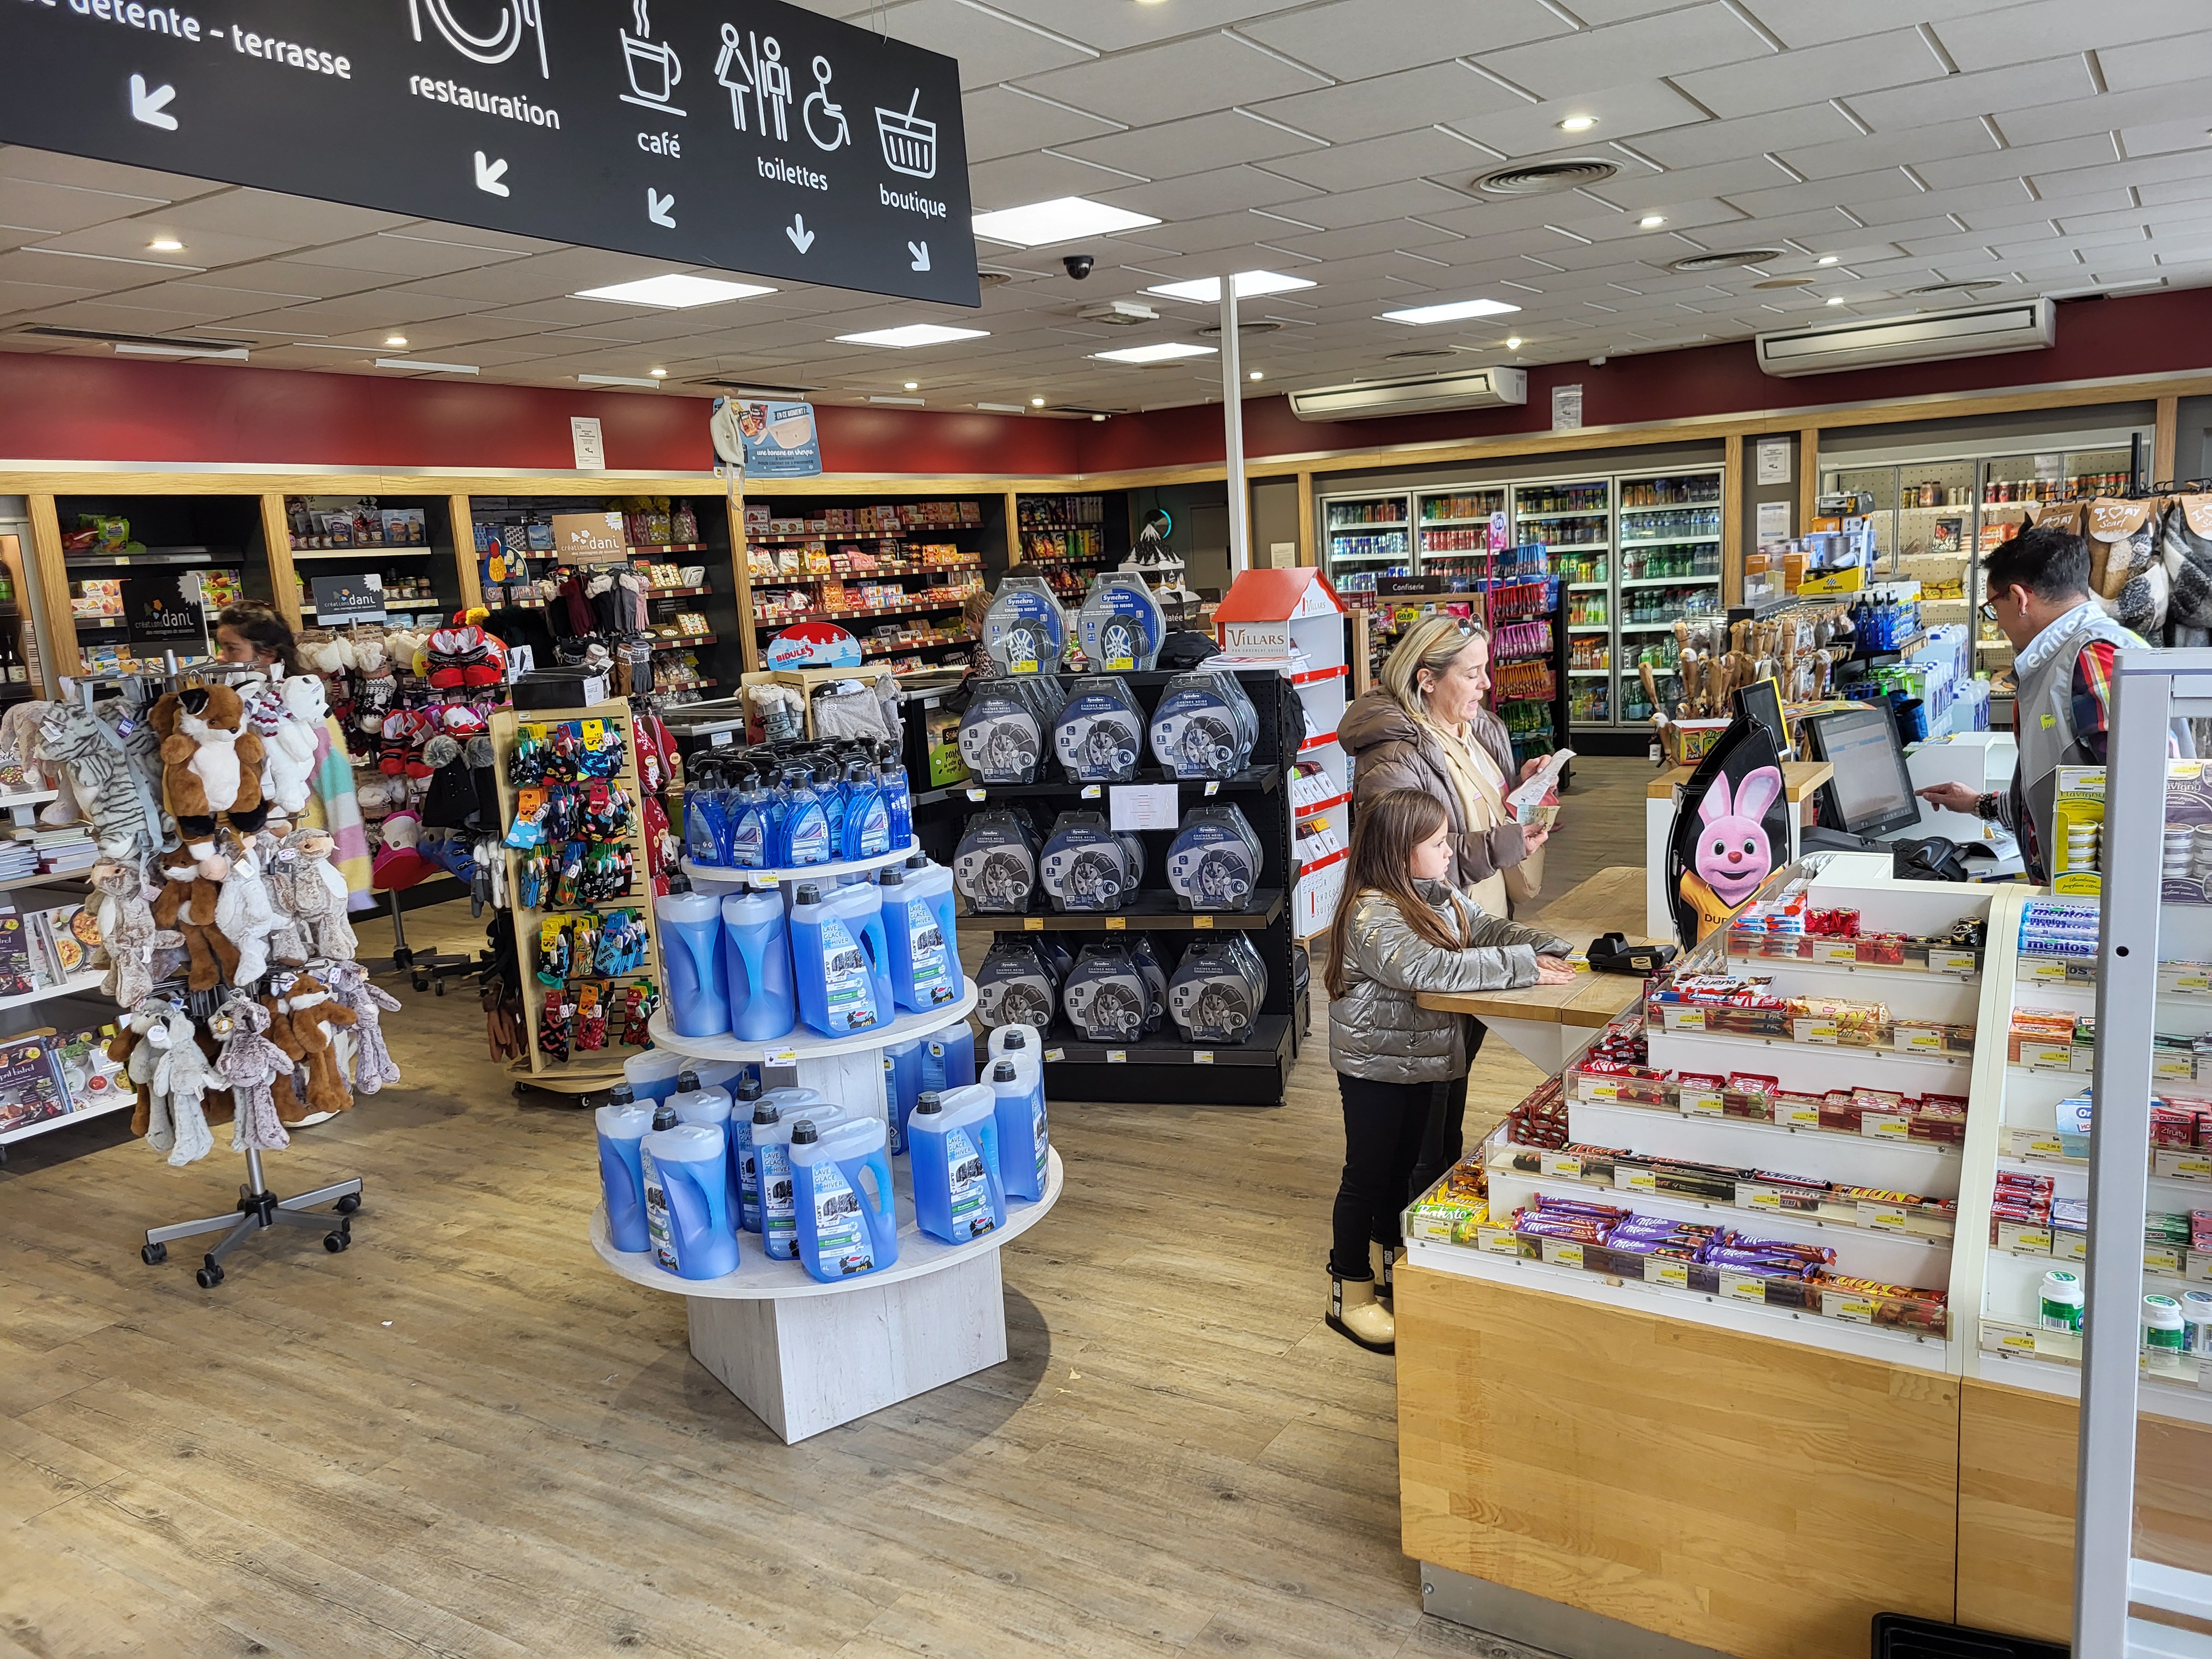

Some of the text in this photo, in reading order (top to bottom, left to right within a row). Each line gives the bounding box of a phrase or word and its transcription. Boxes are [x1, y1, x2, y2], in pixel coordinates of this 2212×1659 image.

[232, 25, 352, 80] terrasse
[410, 75, 560, 130] restauration
[637, 131, 681, 159] café
[757, 155, 828, 192] toilettes
[880, 183, 947, 220] boutique
[788, 408, 803, 418] MOMENT
[2099, 516, 2129, 529] Scarf
[589, 535, 620, 549] dani
[348, 593, 376, 606] dani
[162, 608, 194, 627] dani
[794, 635, 811, 649] LES
[776, 644, 814, 662] BIDULES
[2031, 907, 2094, 919] mentos
[2030, 917, 2067, 925] mentos
[2027, 940, 2089, 953] mentos
[1695, 977, 1736, 986] bueno
[942, 994, 951, 1002] eni
[862, 1019, 872, 1027] eni
[2161, 1126, 2187, 1140] 2fruity
[948, 1136, 961, 1145] LAVE
[948, 1141, 966, 1151] GLACE
[956, 1147, 971, 1156] HIVER
[1849, 1187, 1909, 1202] LION
[1417, 1204, 1468, 1220] Balisto
[1992, 1206, 2030, 1214] STIMOROL
[1636, 1217, 1669, 1225] Milka
[982, 1225, 991, 1234] eni
[1624, 1225, 1658, 1233] Milka
[1613, 1239, 1647, 1248] Milka
[1384, 1250, 1393, 1265] UGG
[1720, 1248, 1756, 1256] Milka
[855, 1264, 867, 1272] eni
[1718, 1262, 1752, 1271] Milka
[1333, 1281, 1341, 1297] UGG
